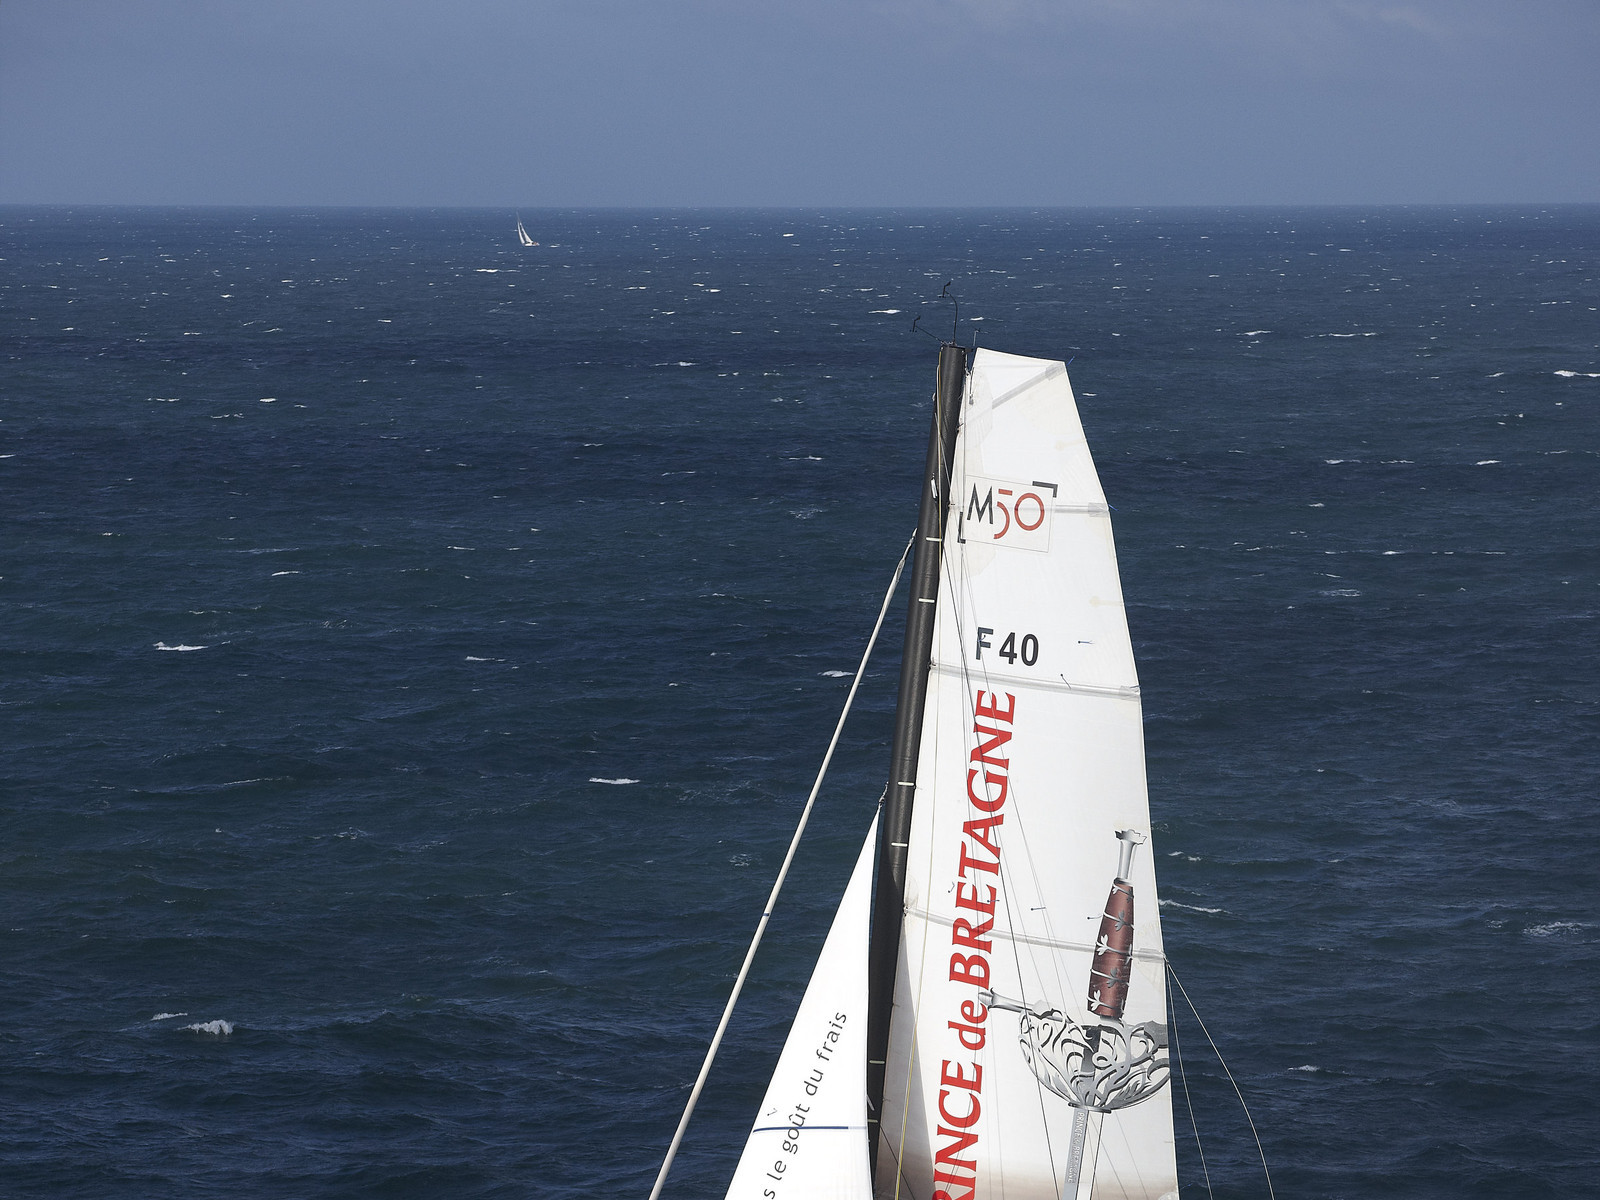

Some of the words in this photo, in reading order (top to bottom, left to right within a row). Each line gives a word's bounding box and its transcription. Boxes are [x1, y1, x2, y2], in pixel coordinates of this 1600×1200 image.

[949, 690, 1016, 989] BRETAGNE
[766, 1158, 788, 1181] le
[782, 1103, 811, 1155] goût
[803, 1070, 824, 1096] du
[816, 1011, 847, 1070] frais
[948, 1001, 988, 1050] de
